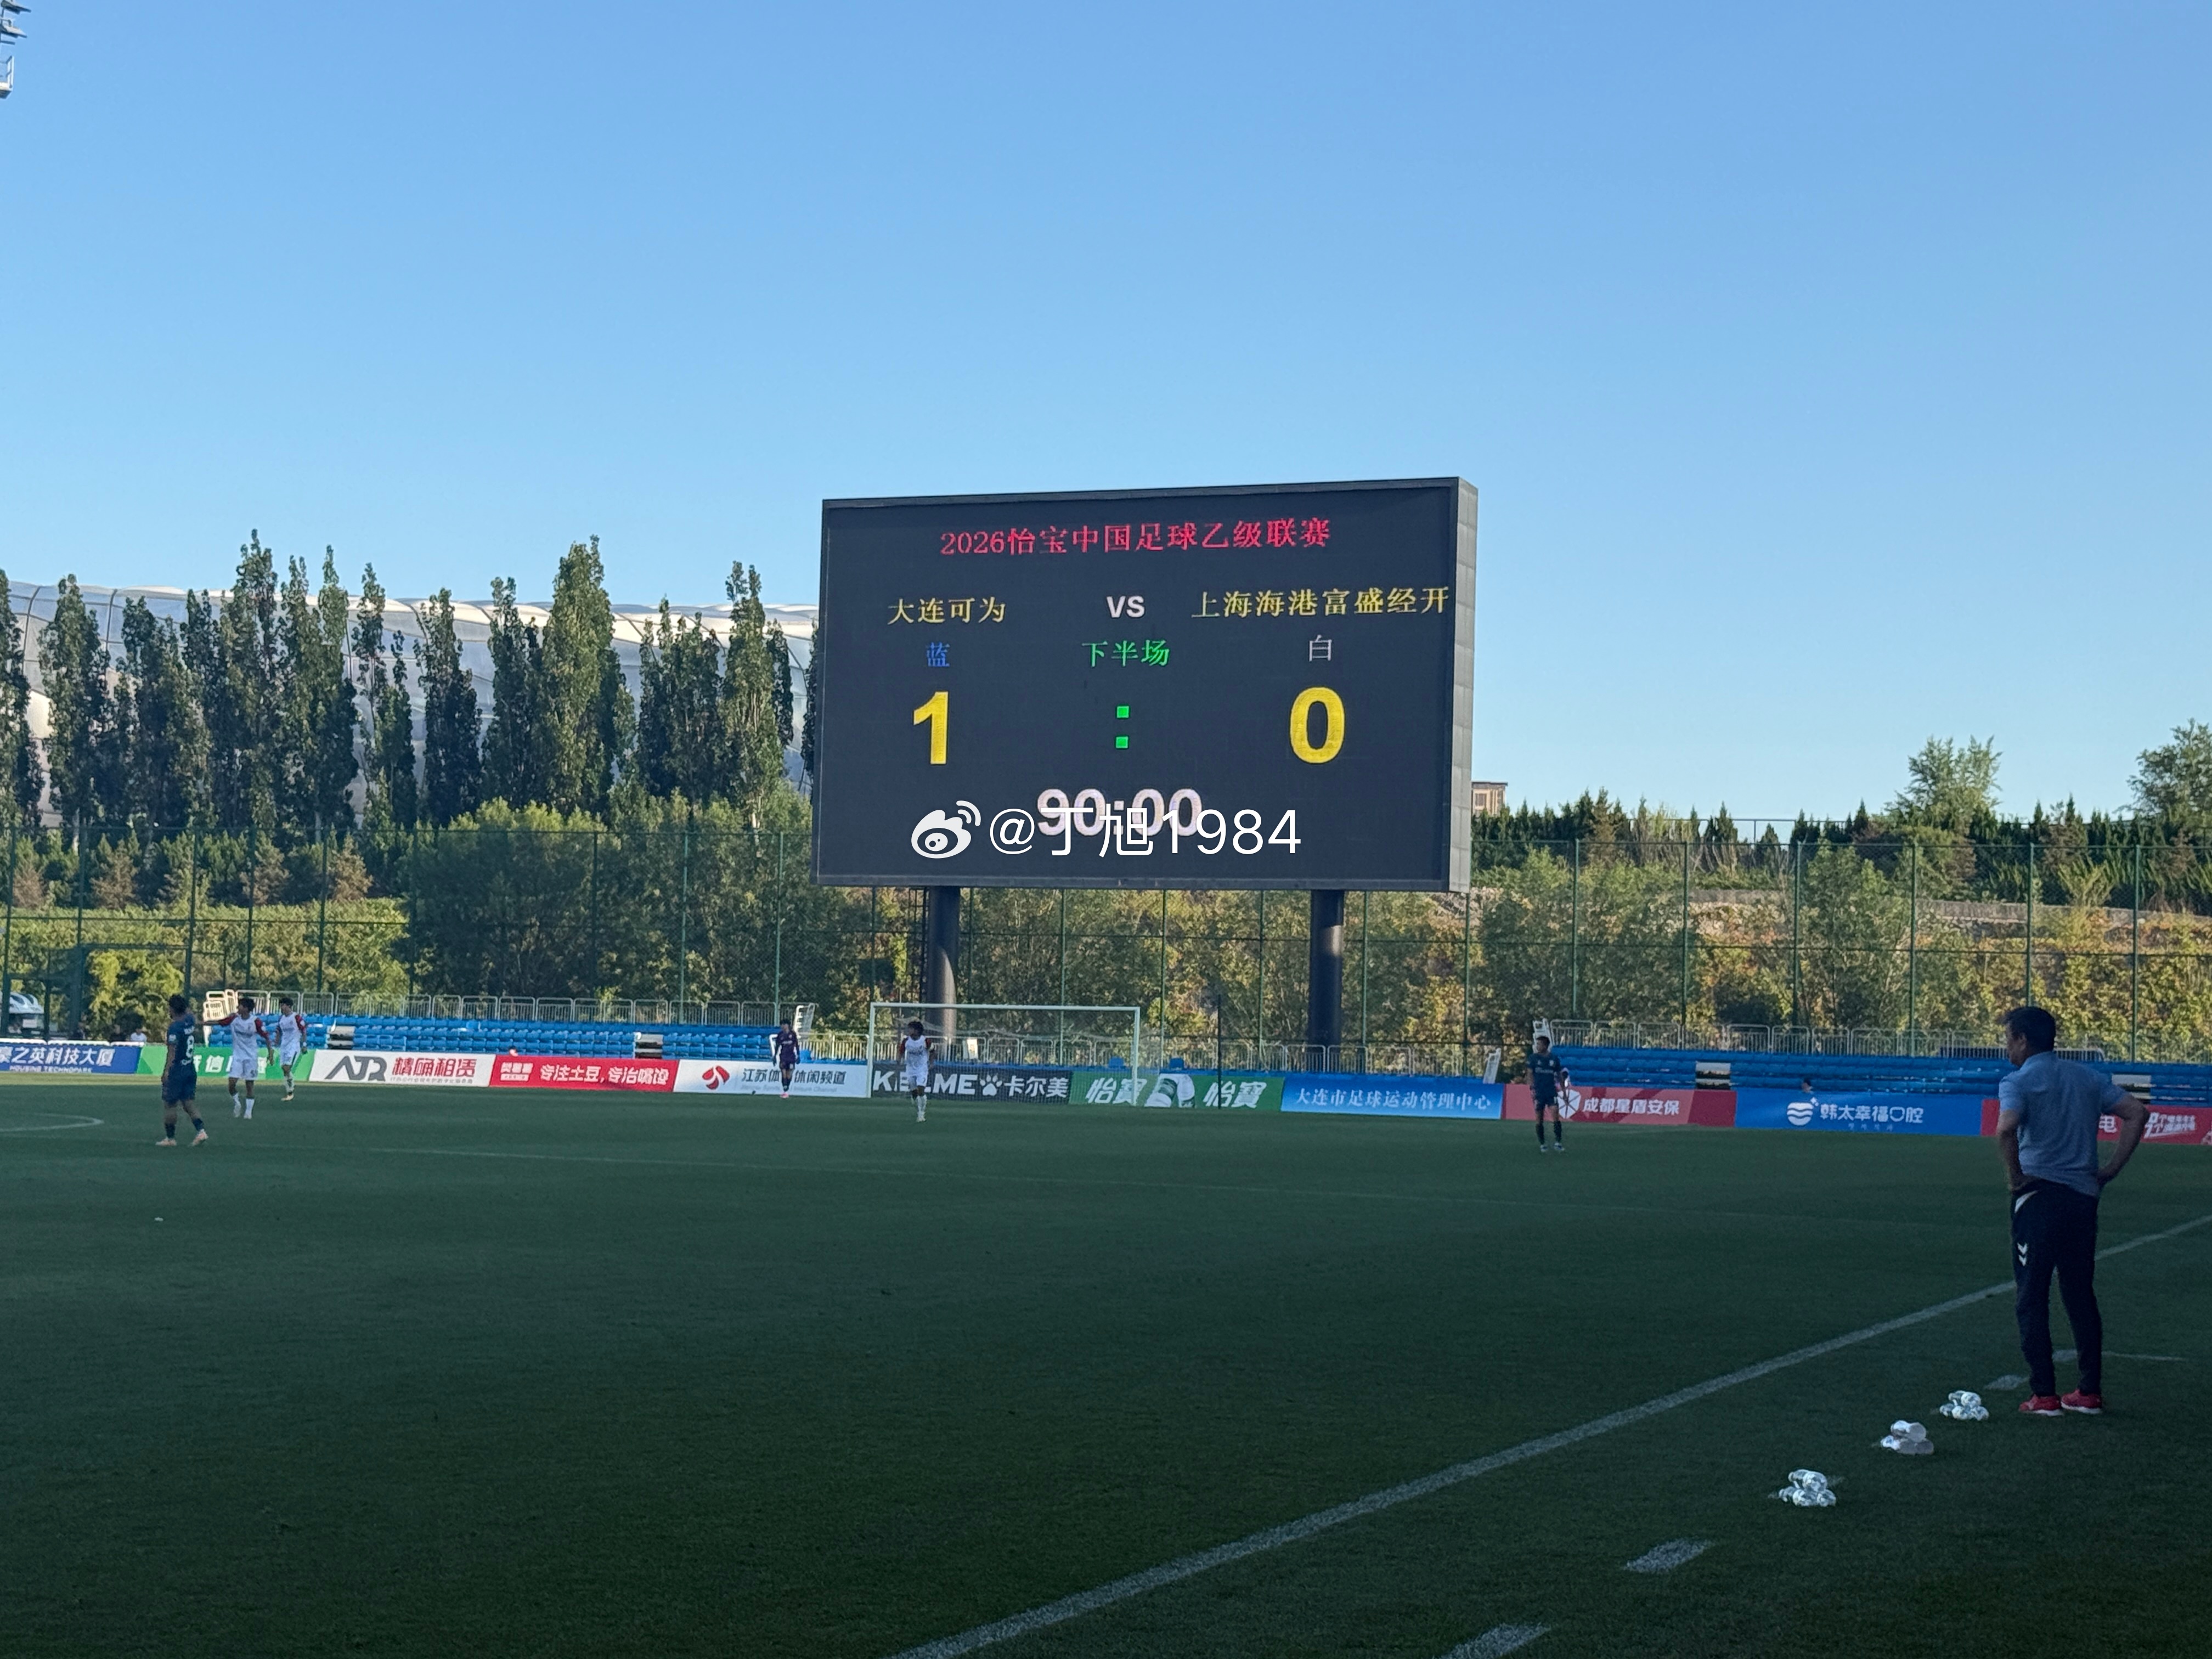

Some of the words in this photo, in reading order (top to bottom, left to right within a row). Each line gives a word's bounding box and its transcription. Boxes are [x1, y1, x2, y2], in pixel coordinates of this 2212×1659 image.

[940, 517, 1330, 555] 2026怡宝中国足球乙级联赛
[888, 596, 1006, 625] 大连可为
[1106, 595, 1145, 618] VS
[1192, 586, 1449, 618] 上海海港富盛经开
[927, 642, 950, 667] 蓝
[1082, 640, 1170, 667] 下半场
[1309, 634, 1332, 662] 白
[913, 691, 949, 765] 1
[1289, 686, 1345, 764] 0
[1037, 788, 1203, 837] 90:00
[742, 1068, 847, 1085] 江苏体休闲频道
[873, 1070, 978, 1094] KEME
[1004, 1075, 1069, 1097] 卡尔美
[1296, 1088, 1491, 1111] 大连市足球运动管理中心
[1582, 1097, 1679, 1115] 成都星盾安保
[1820, 1104, 1924, 1123] 韩太幸福口腔
